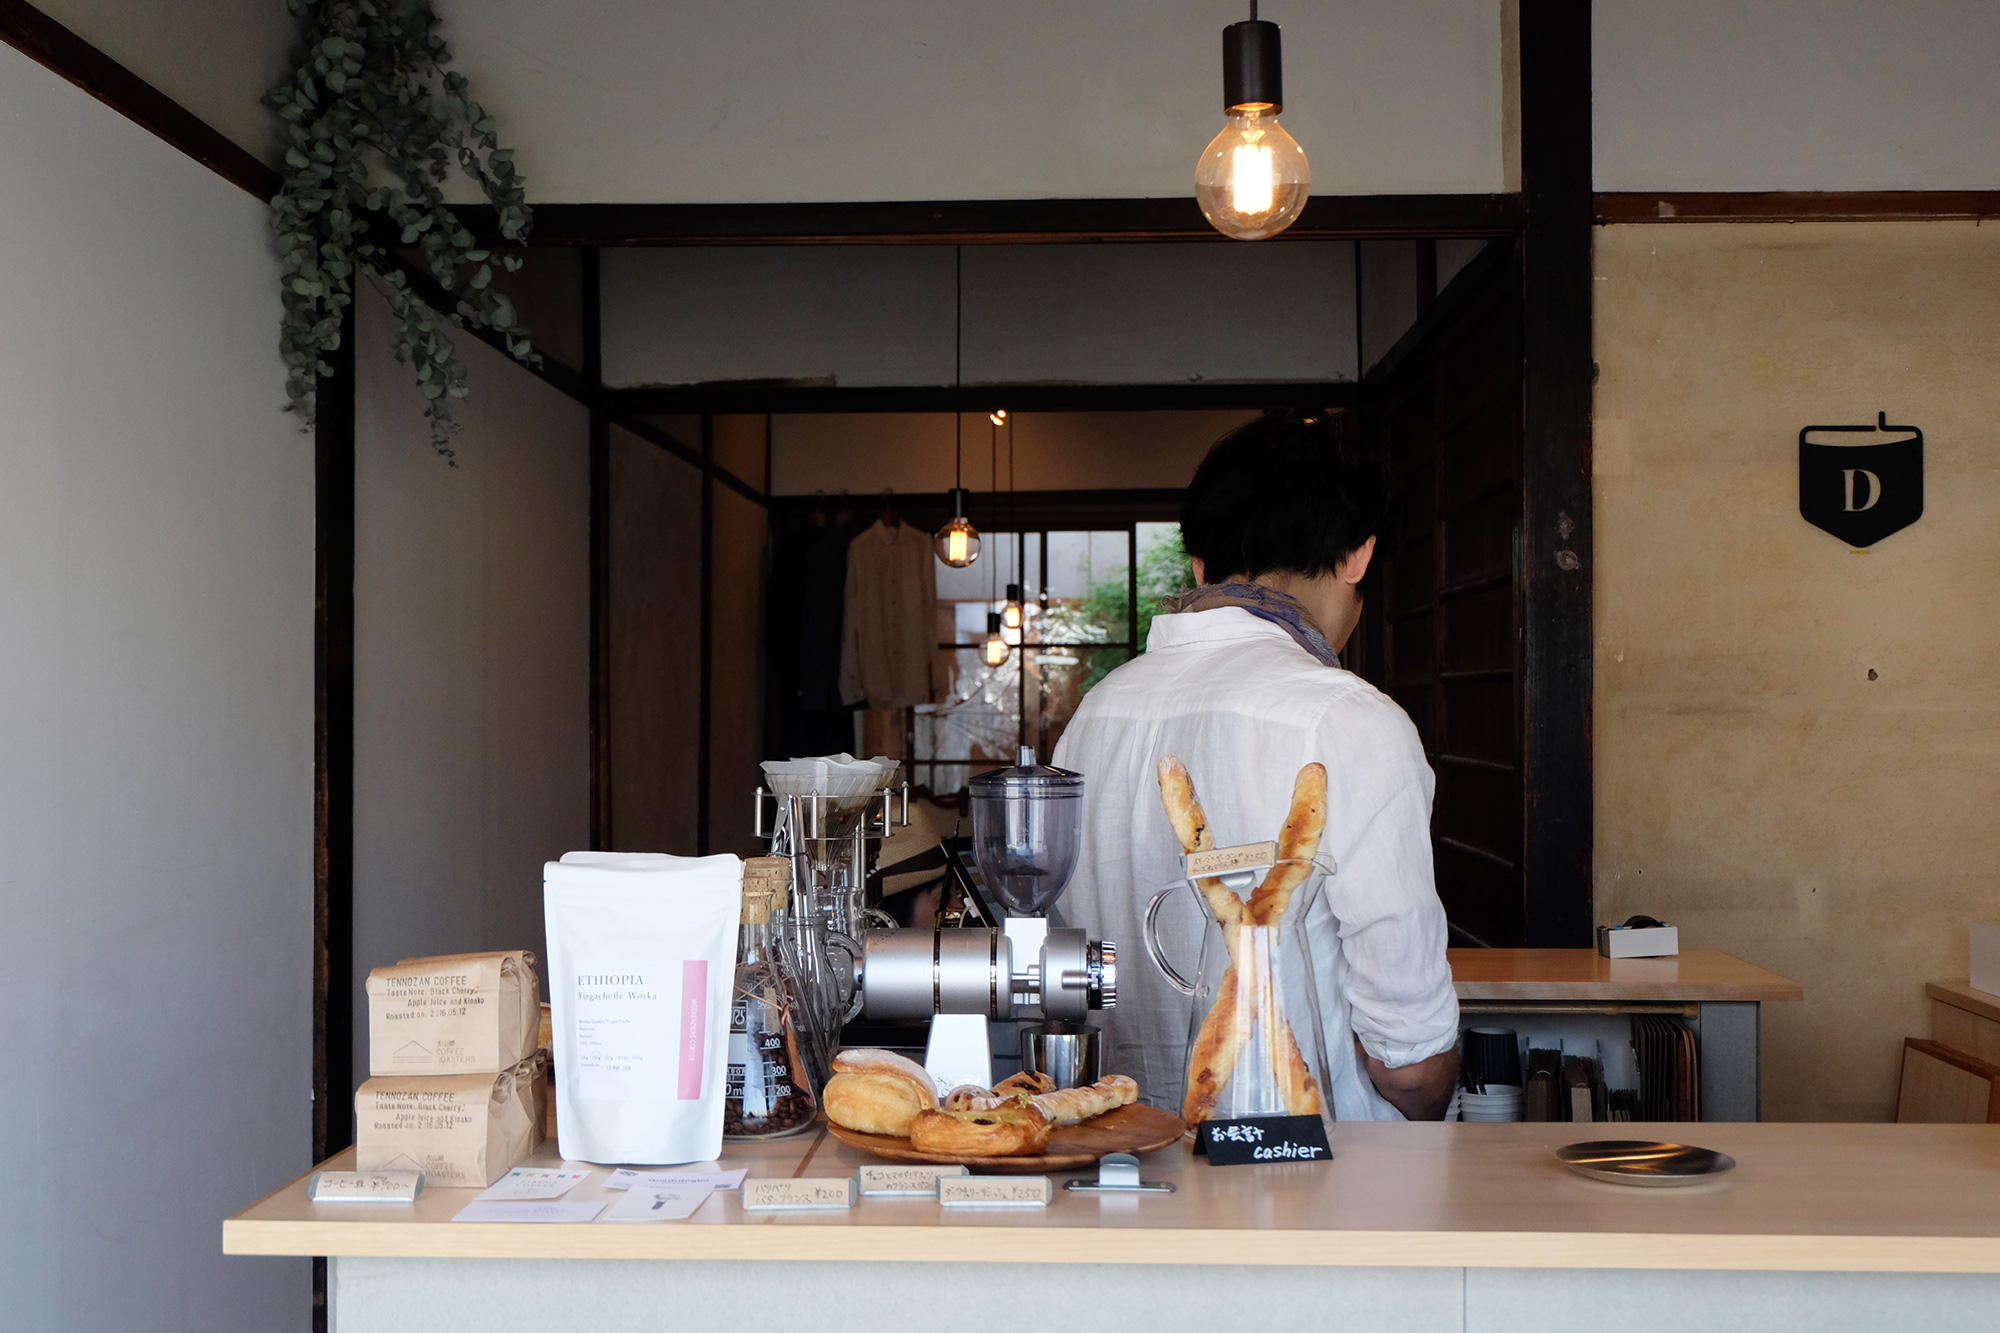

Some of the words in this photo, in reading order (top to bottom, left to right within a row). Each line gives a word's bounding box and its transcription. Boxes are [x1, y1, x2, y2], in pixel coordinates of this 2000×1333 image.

[1841, 468, 1881, 512] D
[386, 977, 430, 987] TENNOZAN
[434, 976, 467, 986] COFFEE
[577, 975, 644, 986] ETHIOPIA
[386, 989, 407, 997] Taste
[430, 987, 449, 995] Black
[577, 991, 624, 1001] Yirgacheffe
[628, 991, 657, 1000] Worka
[407, 999, 427, 1007] Apple
[463, 997, 485, 1005] Kinako
[386, 1012, 414, 1020] Roasted
[764, 1038, 781, 1047] 400
[436, 1047, 465, 1056] COFFEE
[771, 1066, 787, 1075] 300
[776, 1085, 791, 1095] 200
[375, 1091, 419, 1100] TENNOZAN
[422, 1092, 455, 1102] COFFEE
[376, 1102, 395, 1110] Taste
[418, 1103, 436, 1111] Black
[396, 1113, 415, 1122] Apple
[450, 1115, 472, 1123] Kinako
[374, 1121, 403, 1130] Roasted
[417, 1121, 453, 1130] 216.05.12
[1211, 1124, 1265, 1143] お会計
[425, 1162, 454, 1170] COFFEE
[425, 1171, 466, 1179] ROASTERS
[815, 1187, 844, 1200] ¥200
